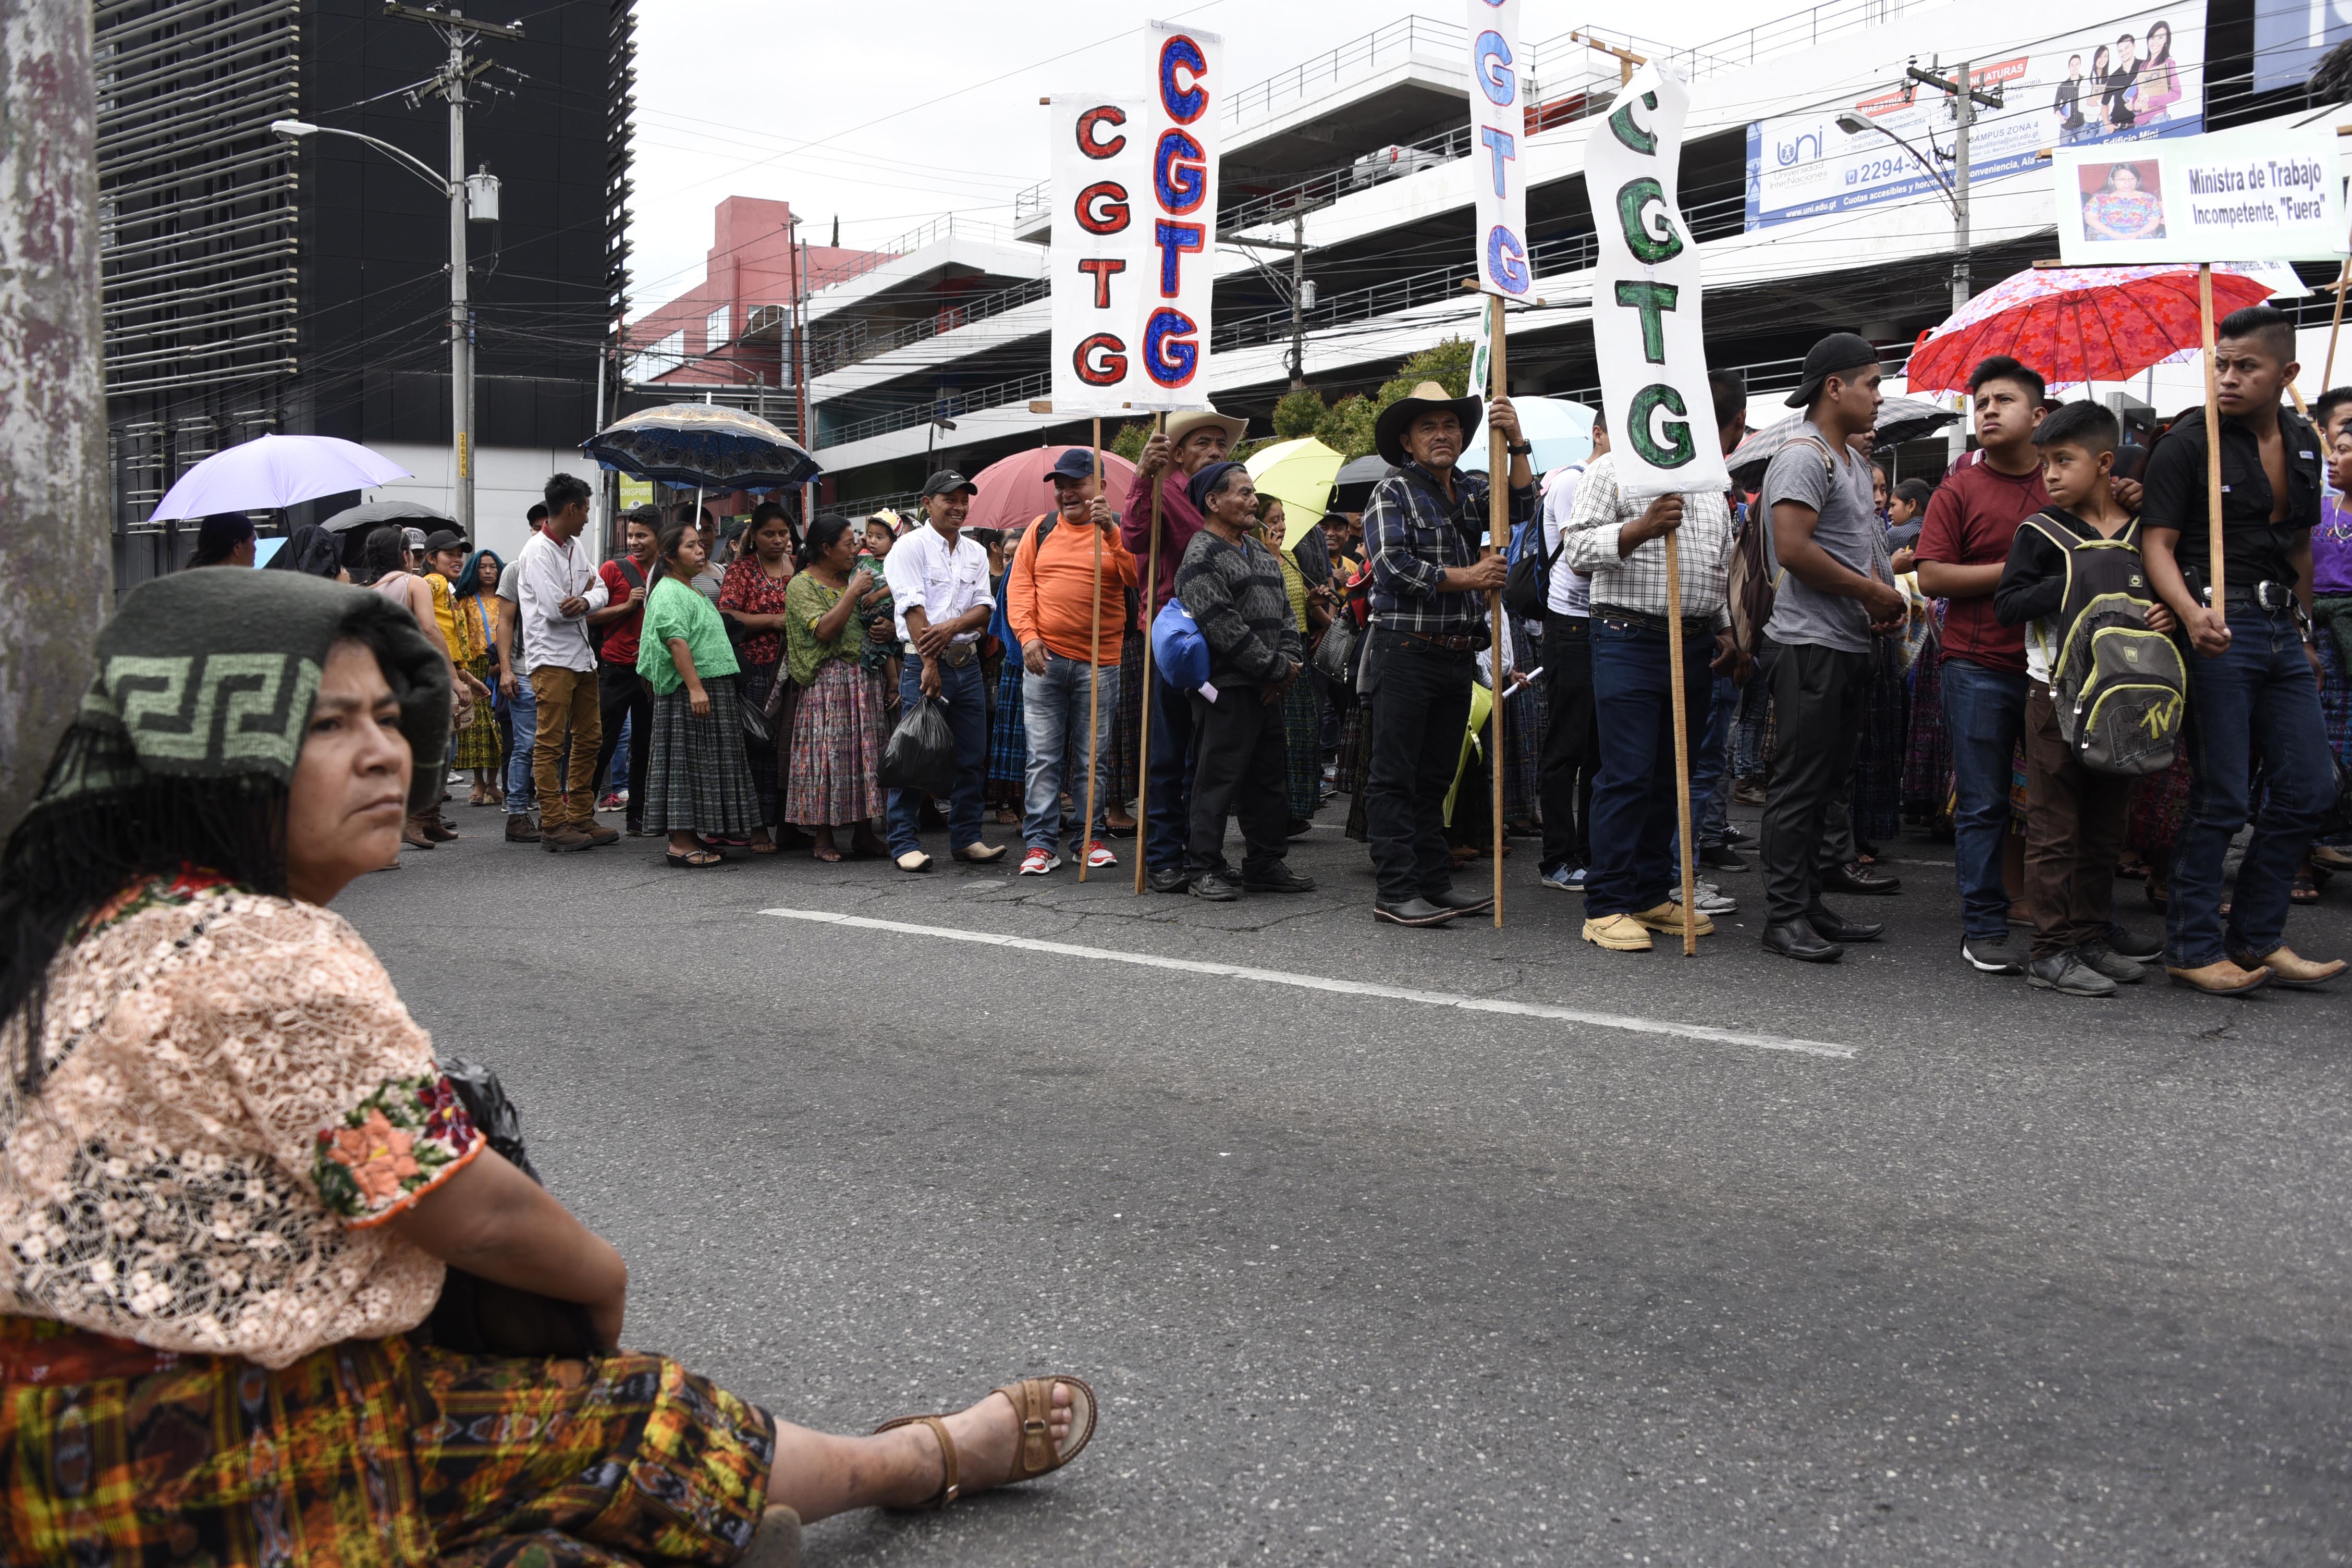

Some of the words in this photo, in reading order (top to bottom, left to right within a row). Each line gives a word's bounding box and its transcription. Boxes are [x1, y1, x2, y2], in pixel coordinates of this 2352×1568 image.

[1777, 125, 1823, 166] uni
[1969, 131, 2039, 152] nfoauditoria@uni.edu.gt
[2007, 123, 2031, 135] ZONA
[1475, 0, 1529, 296] GTG
[1770, 170, 1828, 190] InterNaciones
[1774, 160, 1824, 180] Universidad
[1786, 201, 1836, 218] www.uni.edu.gt
[1843, 194, 1868, 205] Cuotas
[1869, 185, 1907, 200] accesibles
[1908, 184, 1914, 193] y
[2021, 157, 2035, 167] Ala
[2189, 163, 2244, 195] Ministra
[2248, 163, 2265, 190] de
[2268, 157, 2322, 191] Trabajo
[1142, 34, 1209, 389] CGTG
[2192, 200, 2279, 229] Incompetente,
[2280, 193, 2325, 221] "Fuera"
[1073, 105, 1130, 387] CGTG
[620, 487, 651, 496] CHISPUDO
[2116, 756, 2135, 768] MUSIC
[2136, 742, 2171, 761] TELEVISION
